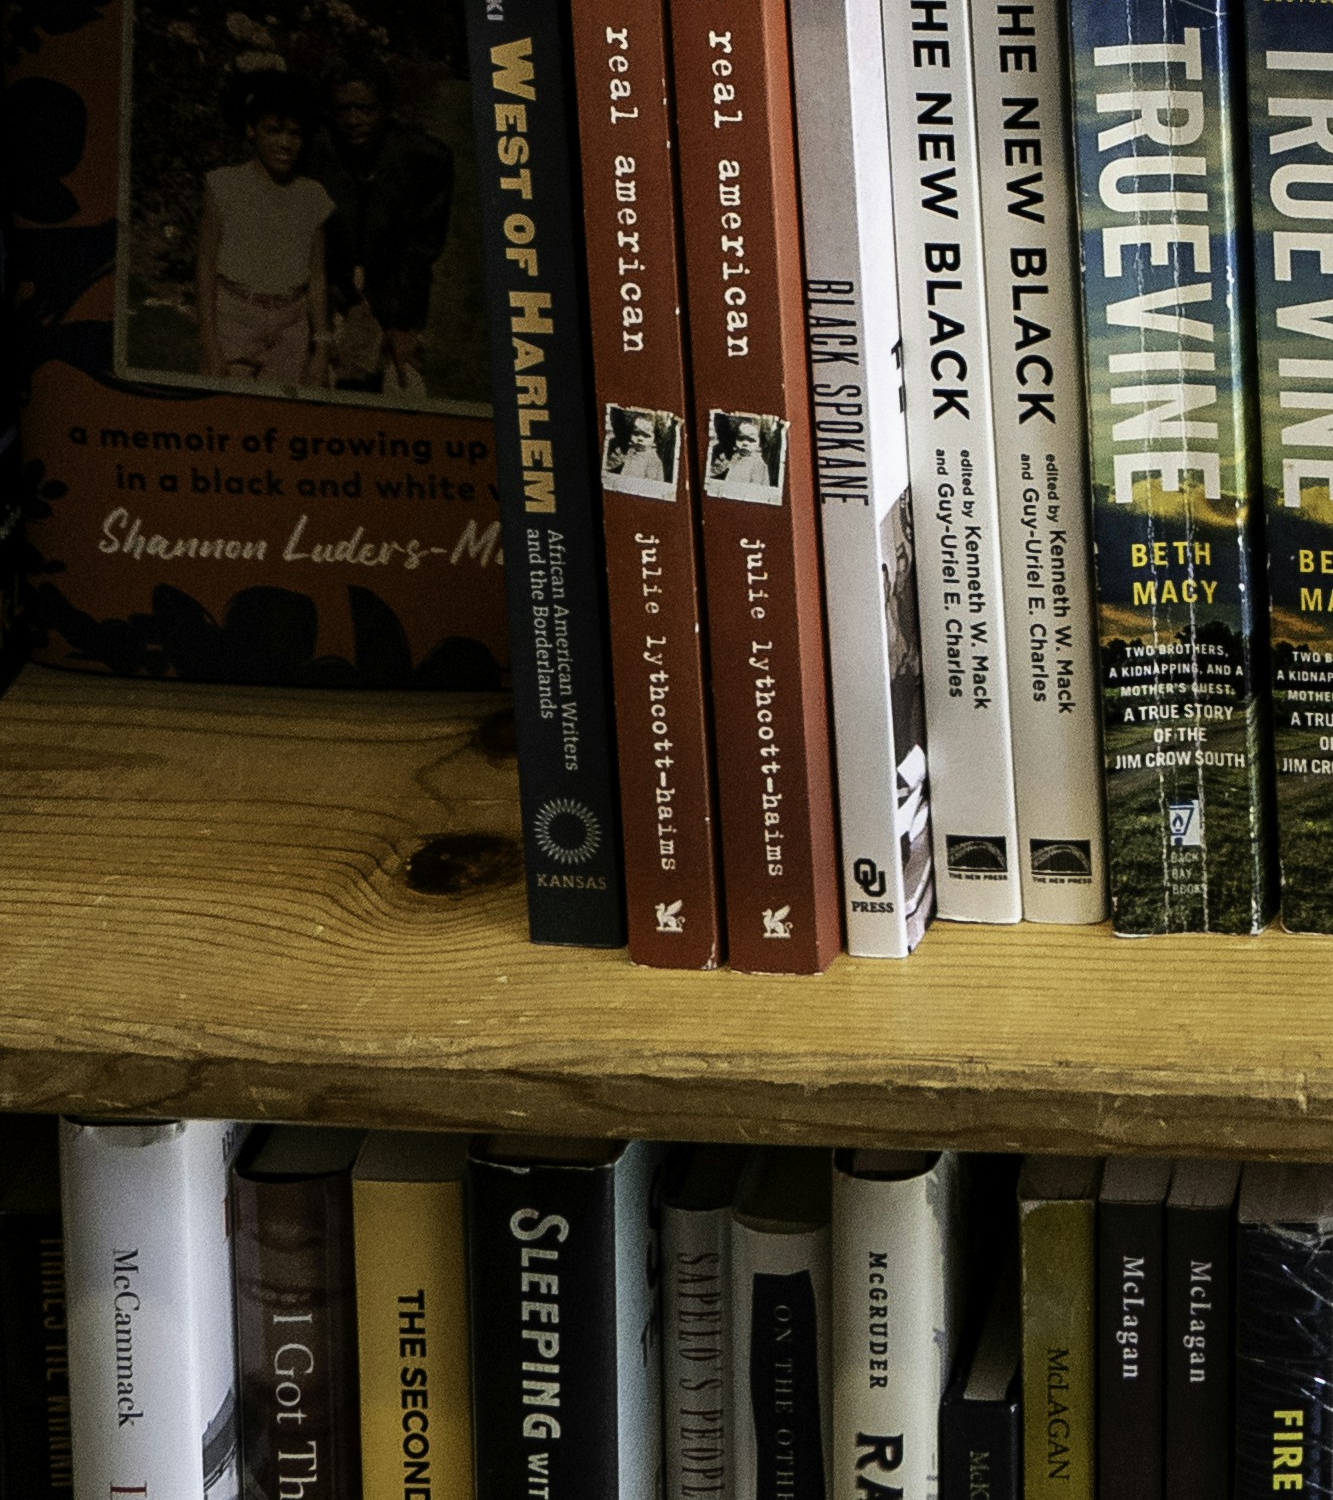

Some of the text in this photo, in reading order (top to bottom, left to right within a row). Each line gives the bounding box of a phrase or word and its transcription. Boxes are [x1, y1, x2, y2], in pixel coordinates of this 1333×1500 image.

[916, 93, 958, 219] NEW
[490, 38, 556, 513] WEST OF HARLEM
[925, 243, 969, 419] BLACK
[1291, 712, 1301, 726] A
[113, 1248, 143, 1428] McCammack
[869, 1253, 890, 1391] McGRUDER
[1116, 1256, 1145, 1378] McLagan
